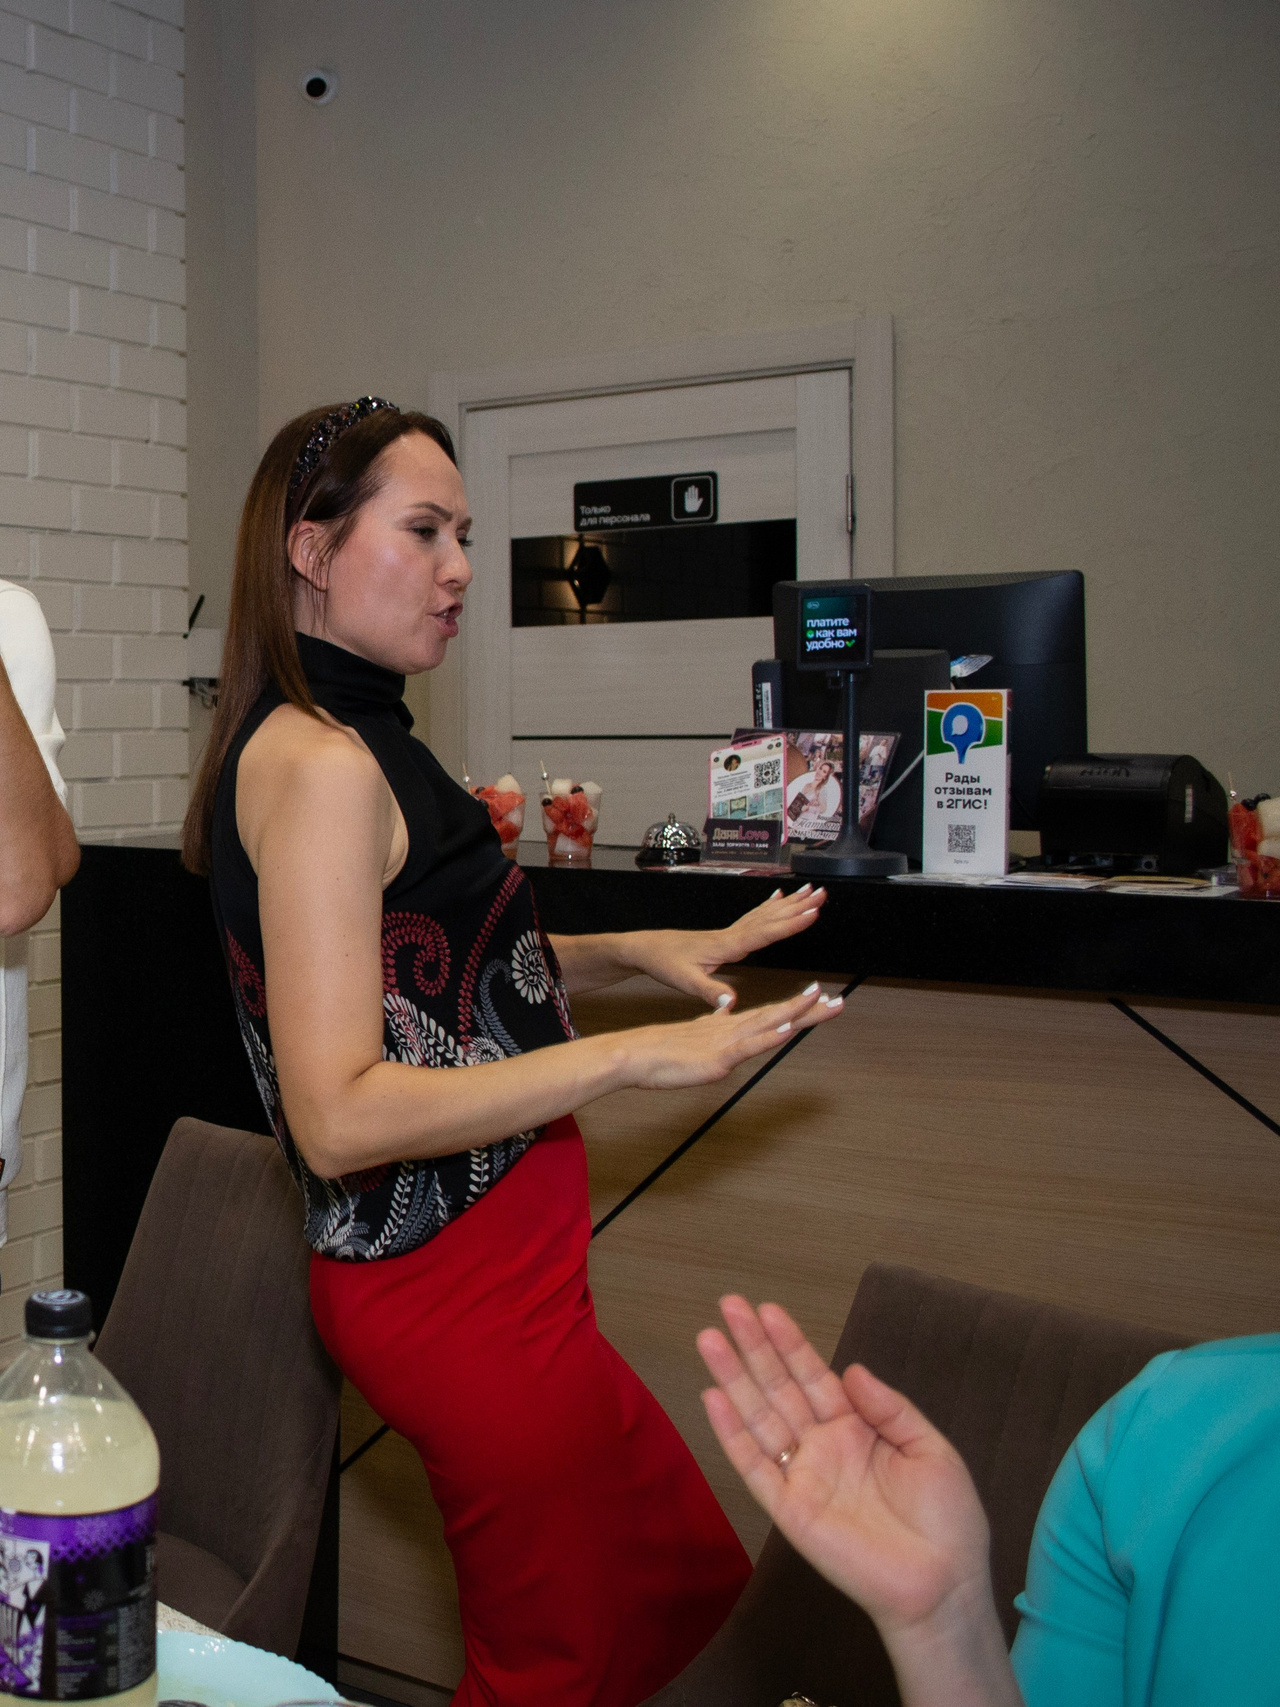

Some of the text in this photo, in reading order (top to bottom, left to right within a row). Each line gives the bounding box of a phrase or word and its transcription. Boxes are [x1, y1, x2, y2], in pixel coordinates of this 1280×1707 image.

[580, 505, 611, 515] Только
[580, 513, 651, 527] для персонала
[806, 617, 850, 628] платите
[815, 628, 858, 638] как вам
[805, 637, 846, 652] удобно
[944, 772, 981, 785] Рады
[934, 785, 993, 797] отзывам
[936, 798, 988, 811] в 2ГИС!
